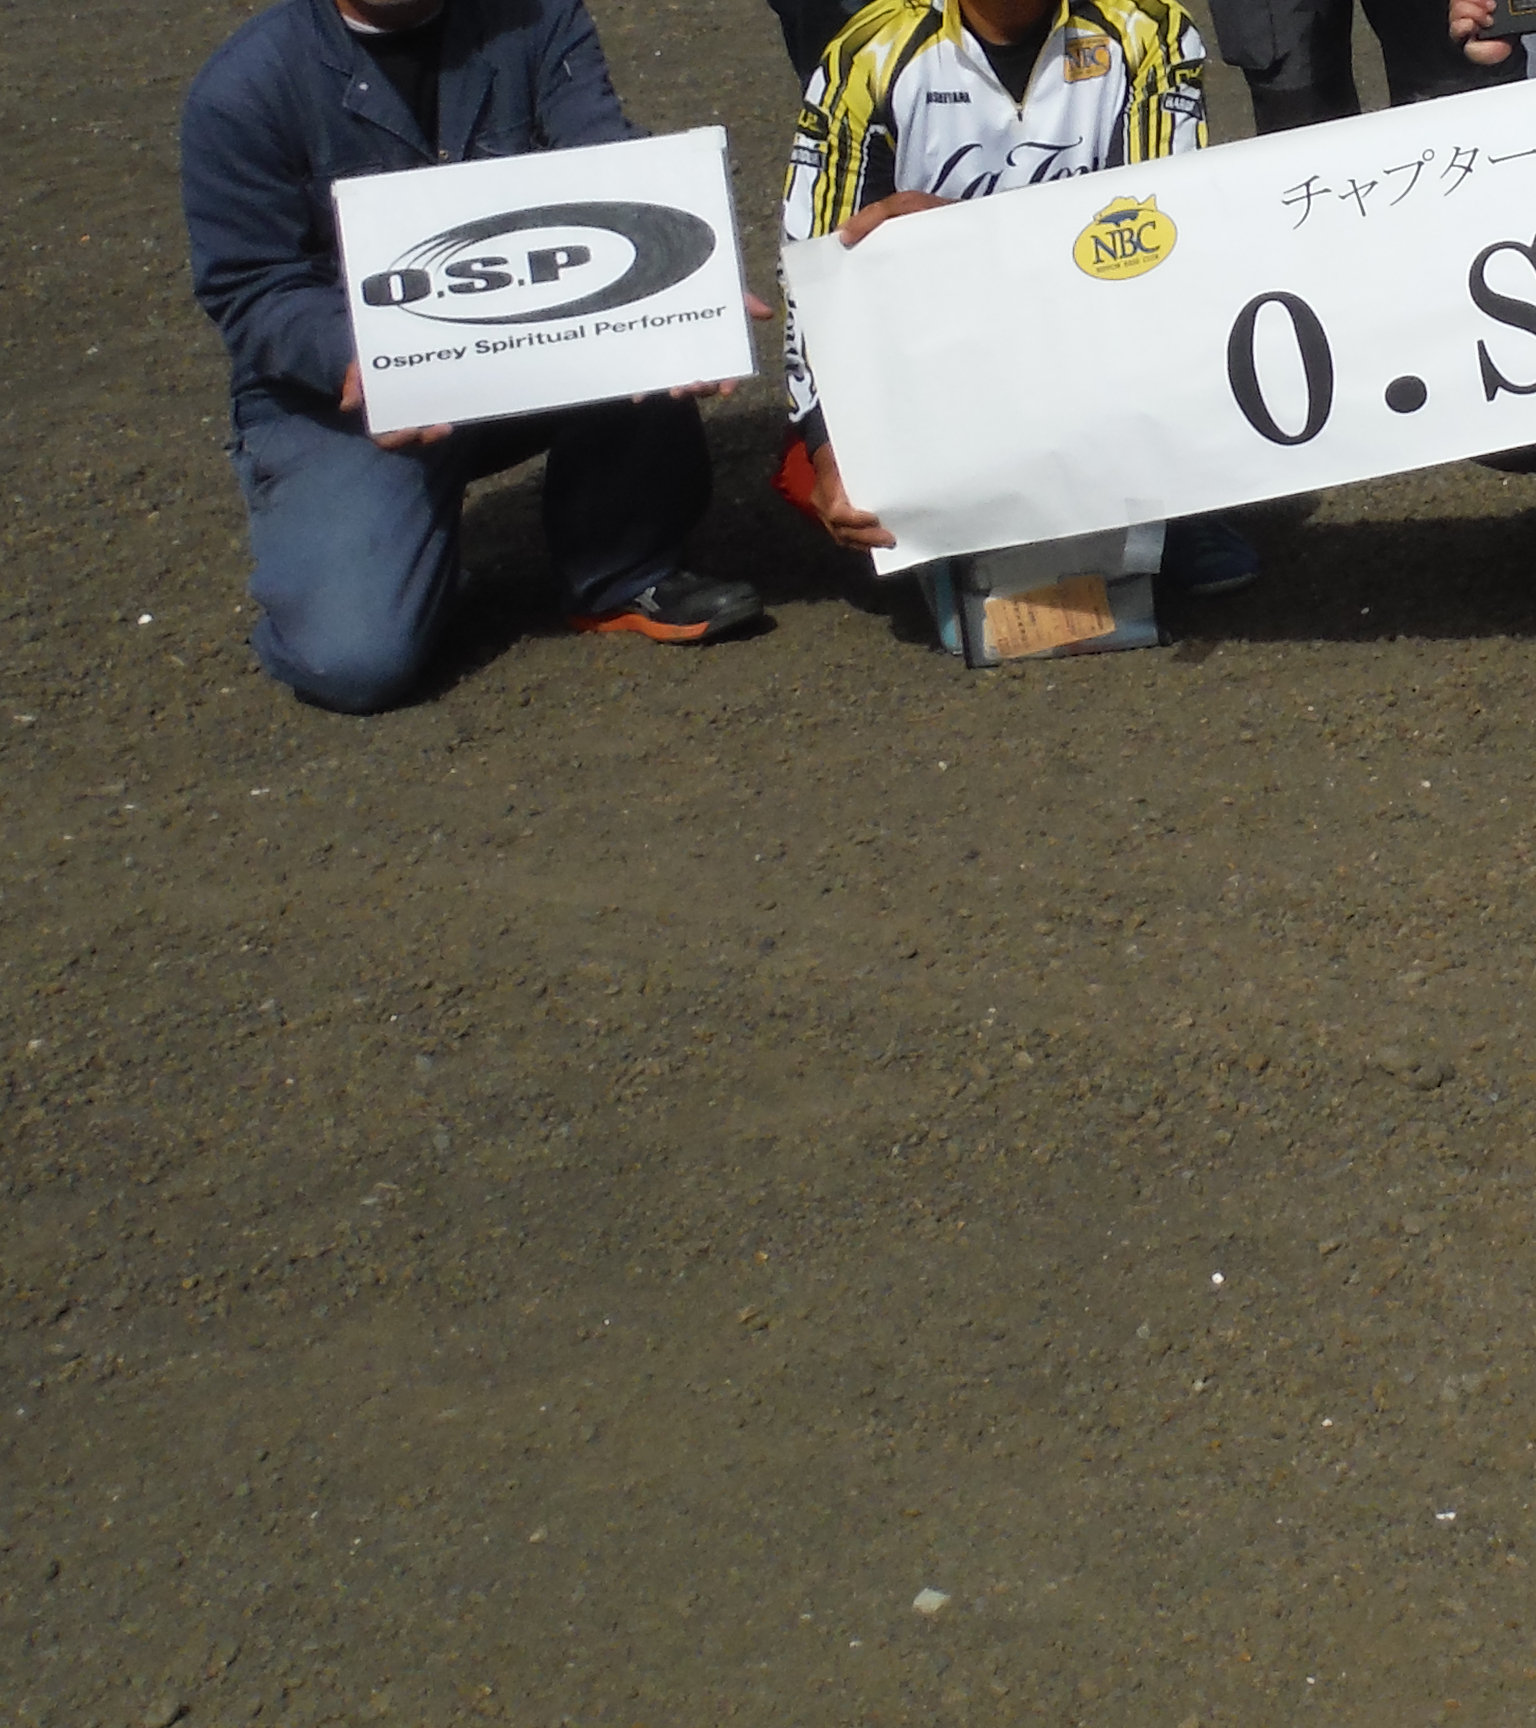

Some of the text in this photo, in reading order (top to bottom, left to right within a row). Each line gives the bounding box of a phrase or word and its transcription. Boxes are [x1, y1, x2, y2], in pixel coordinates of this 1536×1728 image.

[1090, 220, 1161, 265] NBC
[362, 244, 591, 308] O.S.P
[372, 305, 728, 371] Osprey Spiritual Performer
